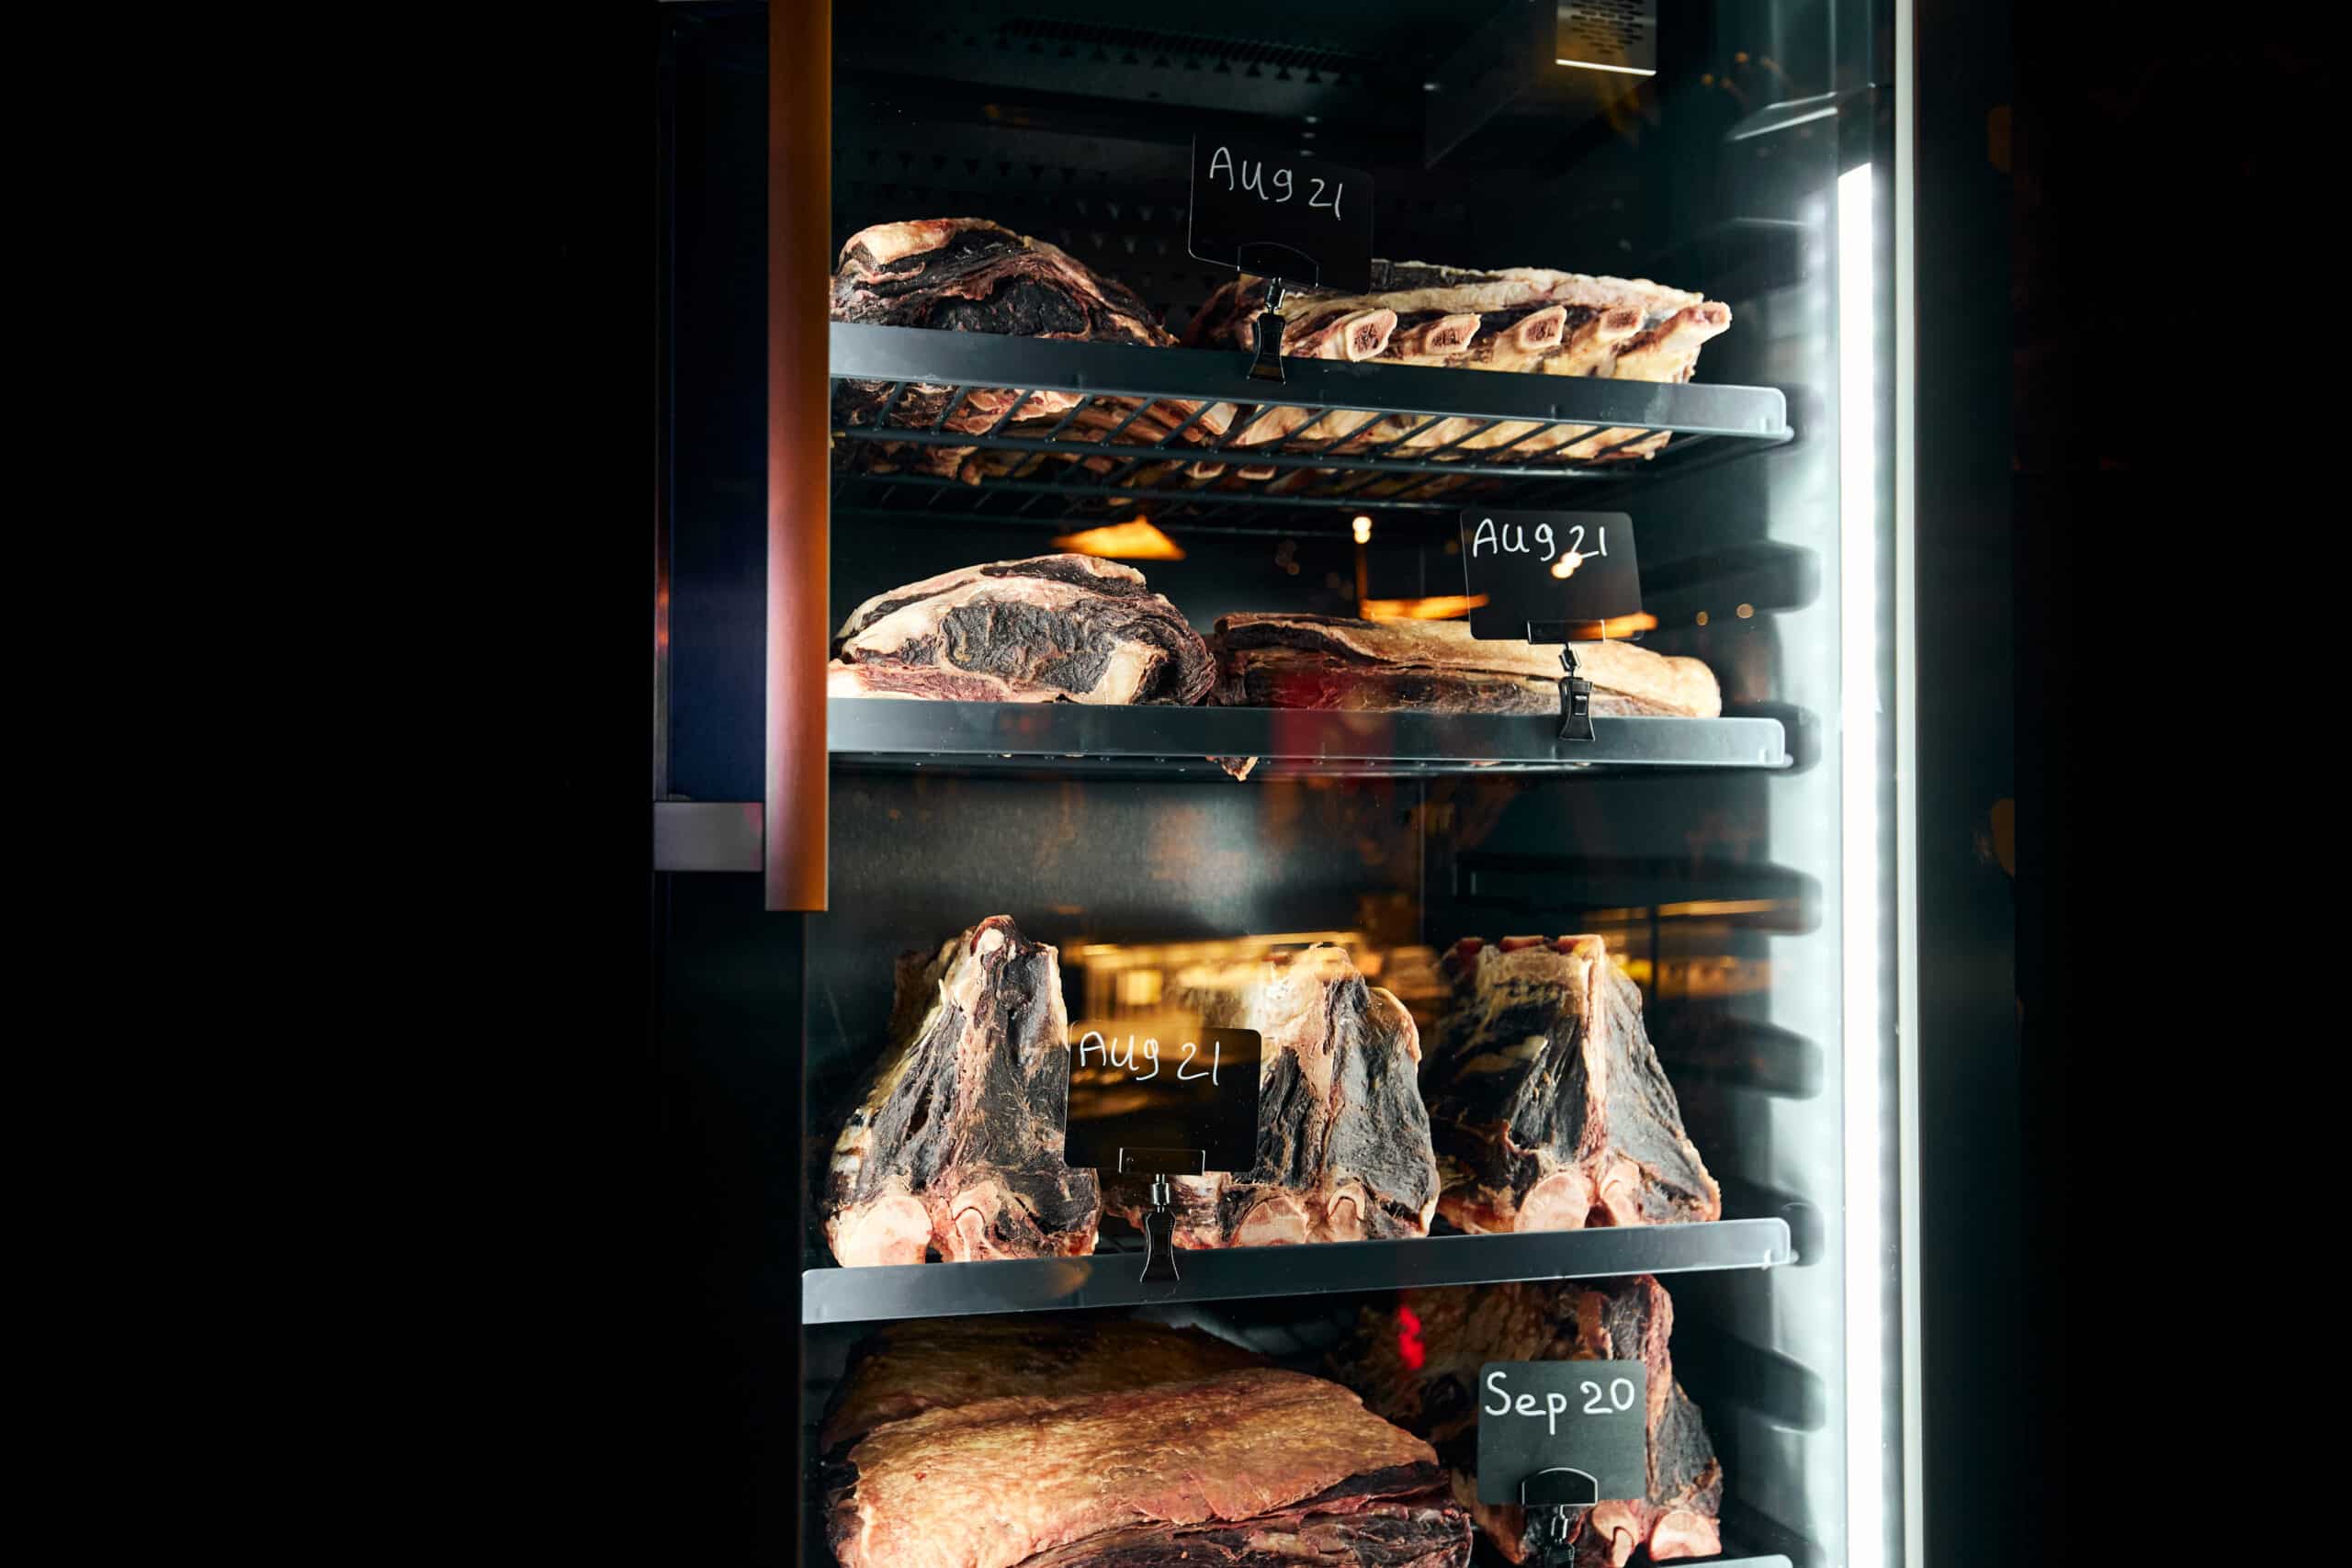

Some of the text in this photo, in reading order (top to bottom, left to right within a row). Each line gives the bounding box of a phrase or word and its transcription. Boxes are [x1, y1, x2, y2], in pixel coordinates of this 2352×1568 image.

[1209, 146, 1343, 220] Aug 21
[1473, 518, 1608, 561] Aug 21
[1080, 1031, 1220, 1087] Aug 21
[1485, 1371, 1635, 1436] Sep 20
